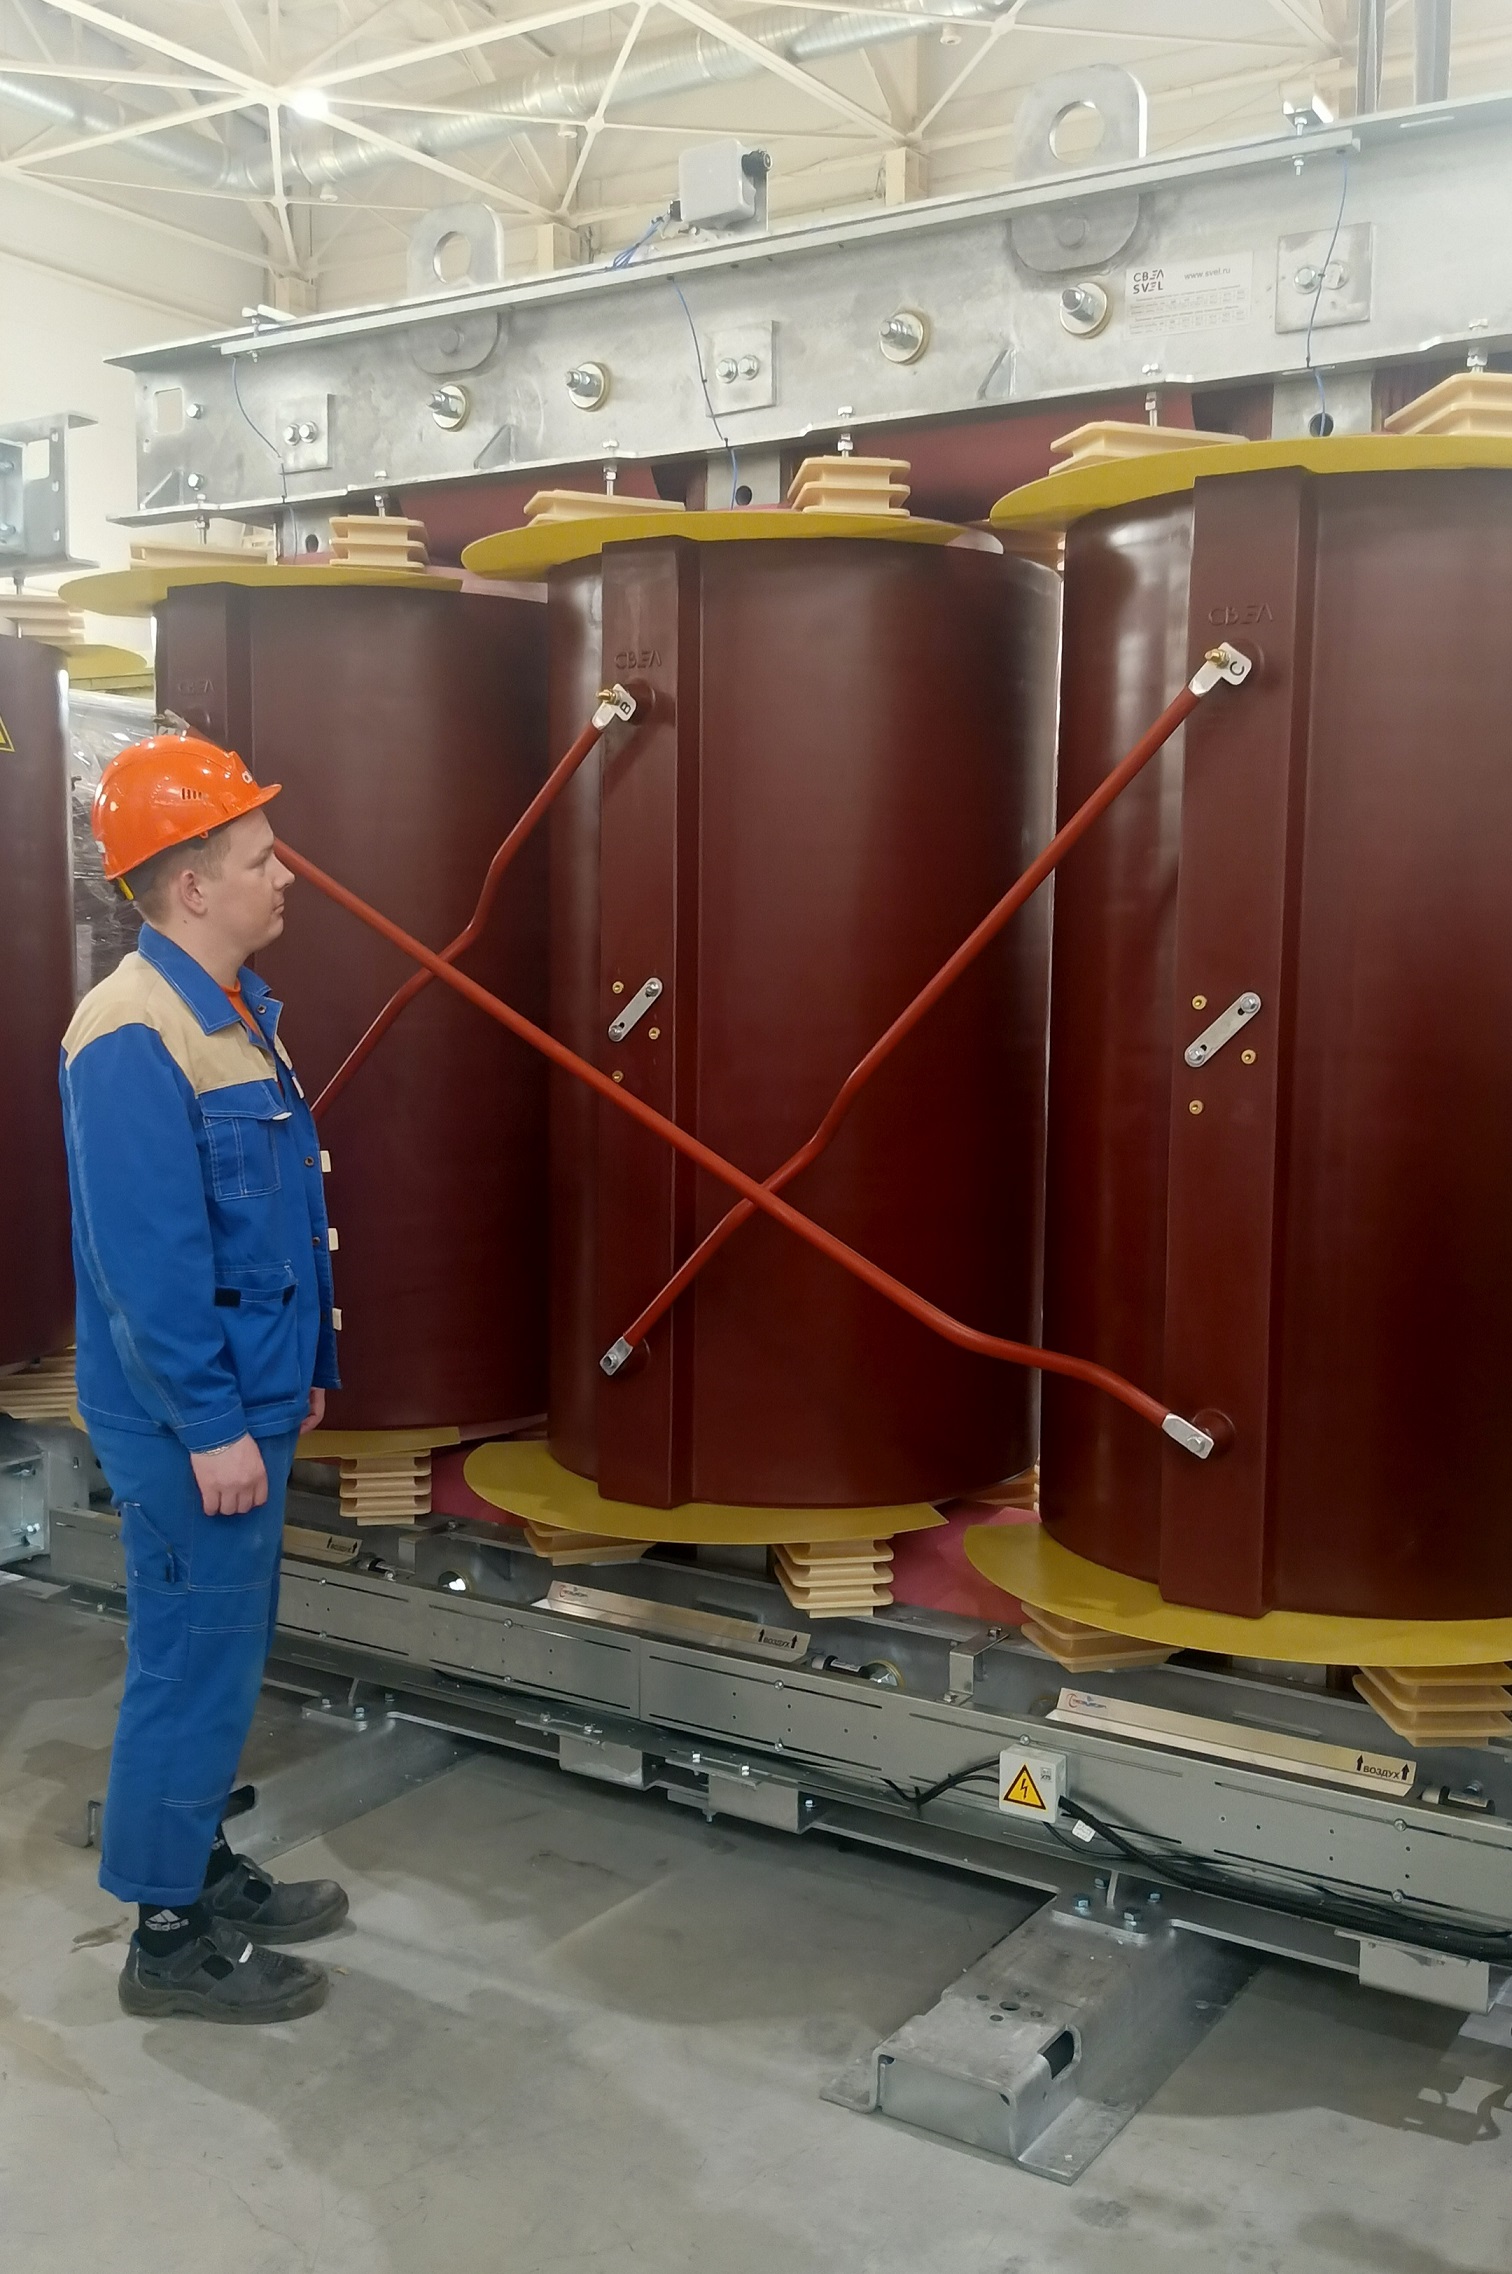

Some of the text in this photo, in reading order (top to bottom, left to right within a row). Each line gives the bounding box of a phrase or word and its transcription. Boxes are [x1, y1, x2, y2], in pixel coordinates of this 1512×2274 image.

[1184, 267, 1231, 280] www.svel.ru
[1133, 281, 1164, 295] SVEL
[1229, 661, 1245, 676] C
[1363, 1765, 1400, 1779] ВОЗДУХ
[145, 1918, 190, 1932] adidas
